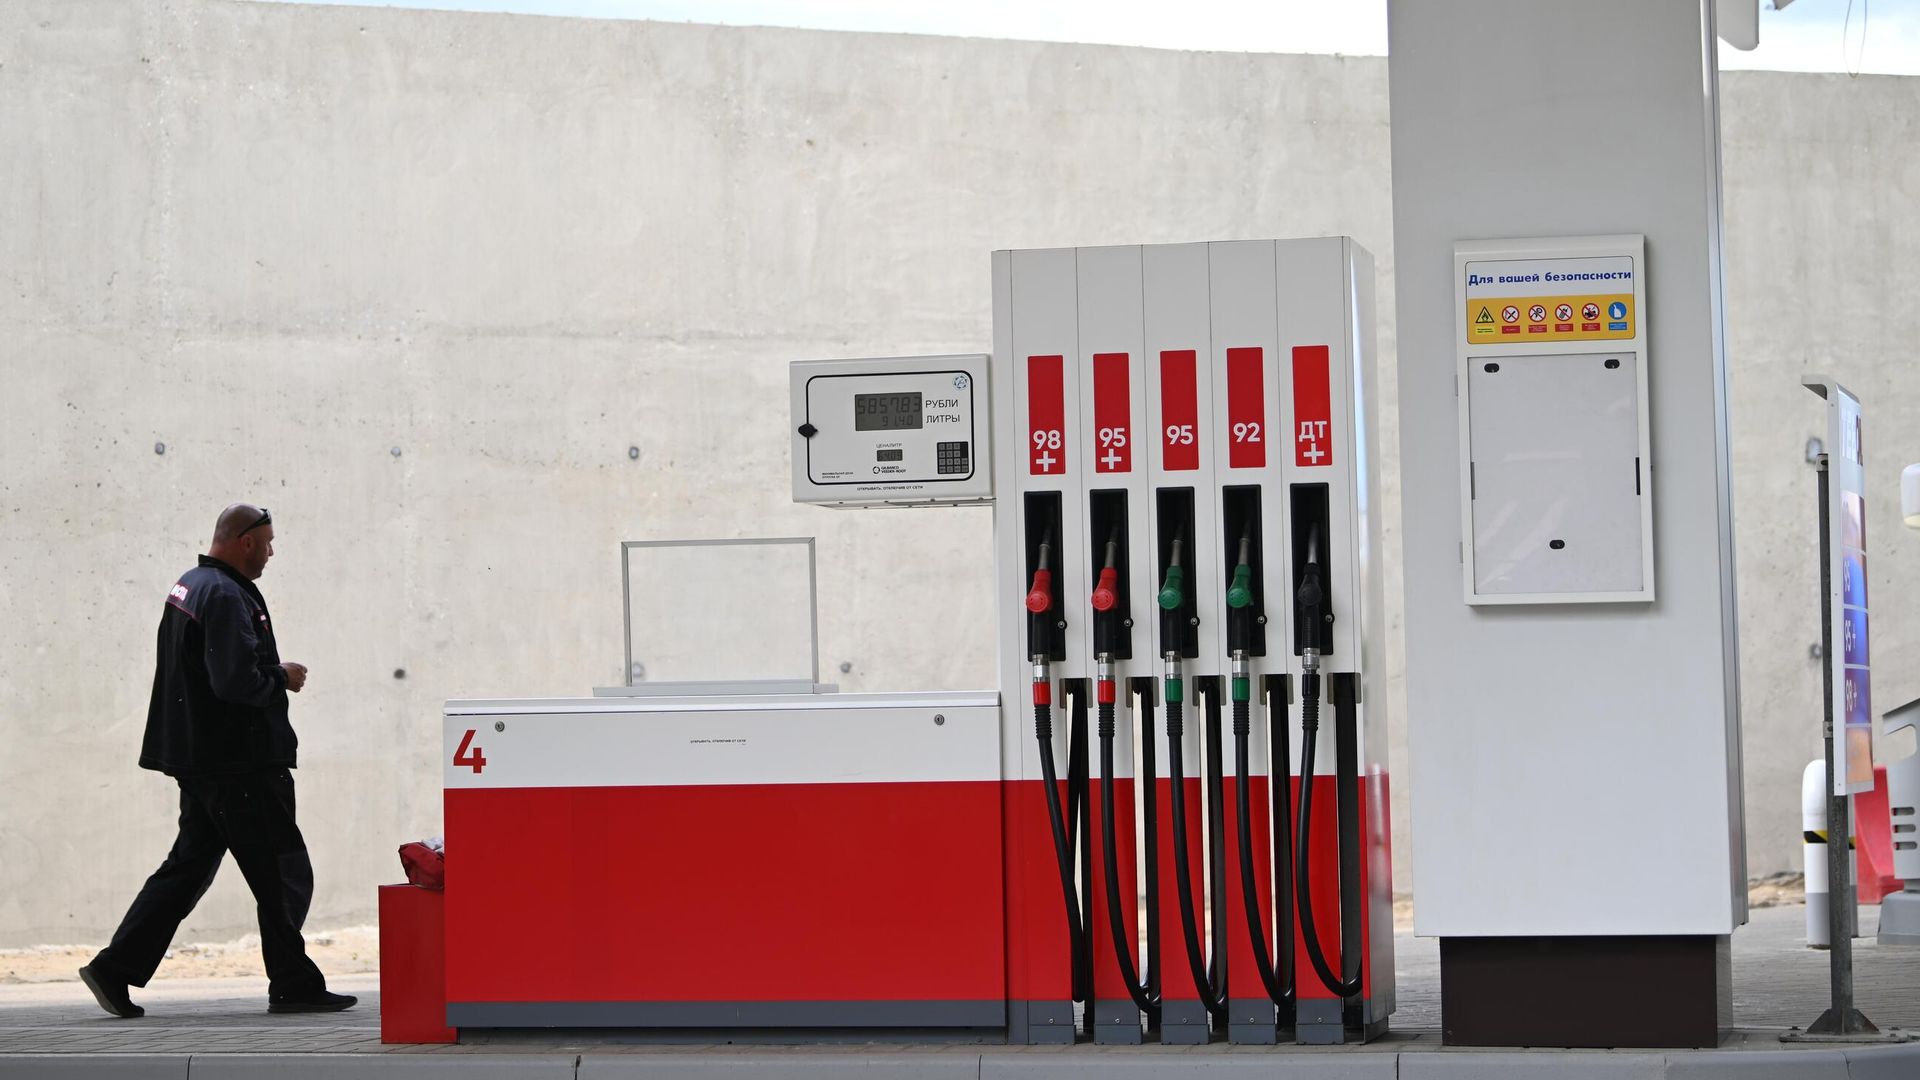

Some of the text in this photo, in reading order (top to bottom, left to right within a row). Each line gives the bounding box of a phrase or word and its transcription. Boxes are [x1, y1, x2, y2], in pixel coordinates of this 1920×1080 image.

[1468, 271, 1632, 286] Для вашей безопасности
[925, 399, 958, 408] РУБЛИ
[926, 415, 960, 423] ЛИТРЫ
[1033, 430, 1061, 450] 98
[1099, 427, 1126, 448] 95
[1166, 425, 1194, 445] 95
[1233, 422, 1261, 443] 92
[1298, 421, 1328, 443] ДТ
[453, 730, 487, 774] 4
